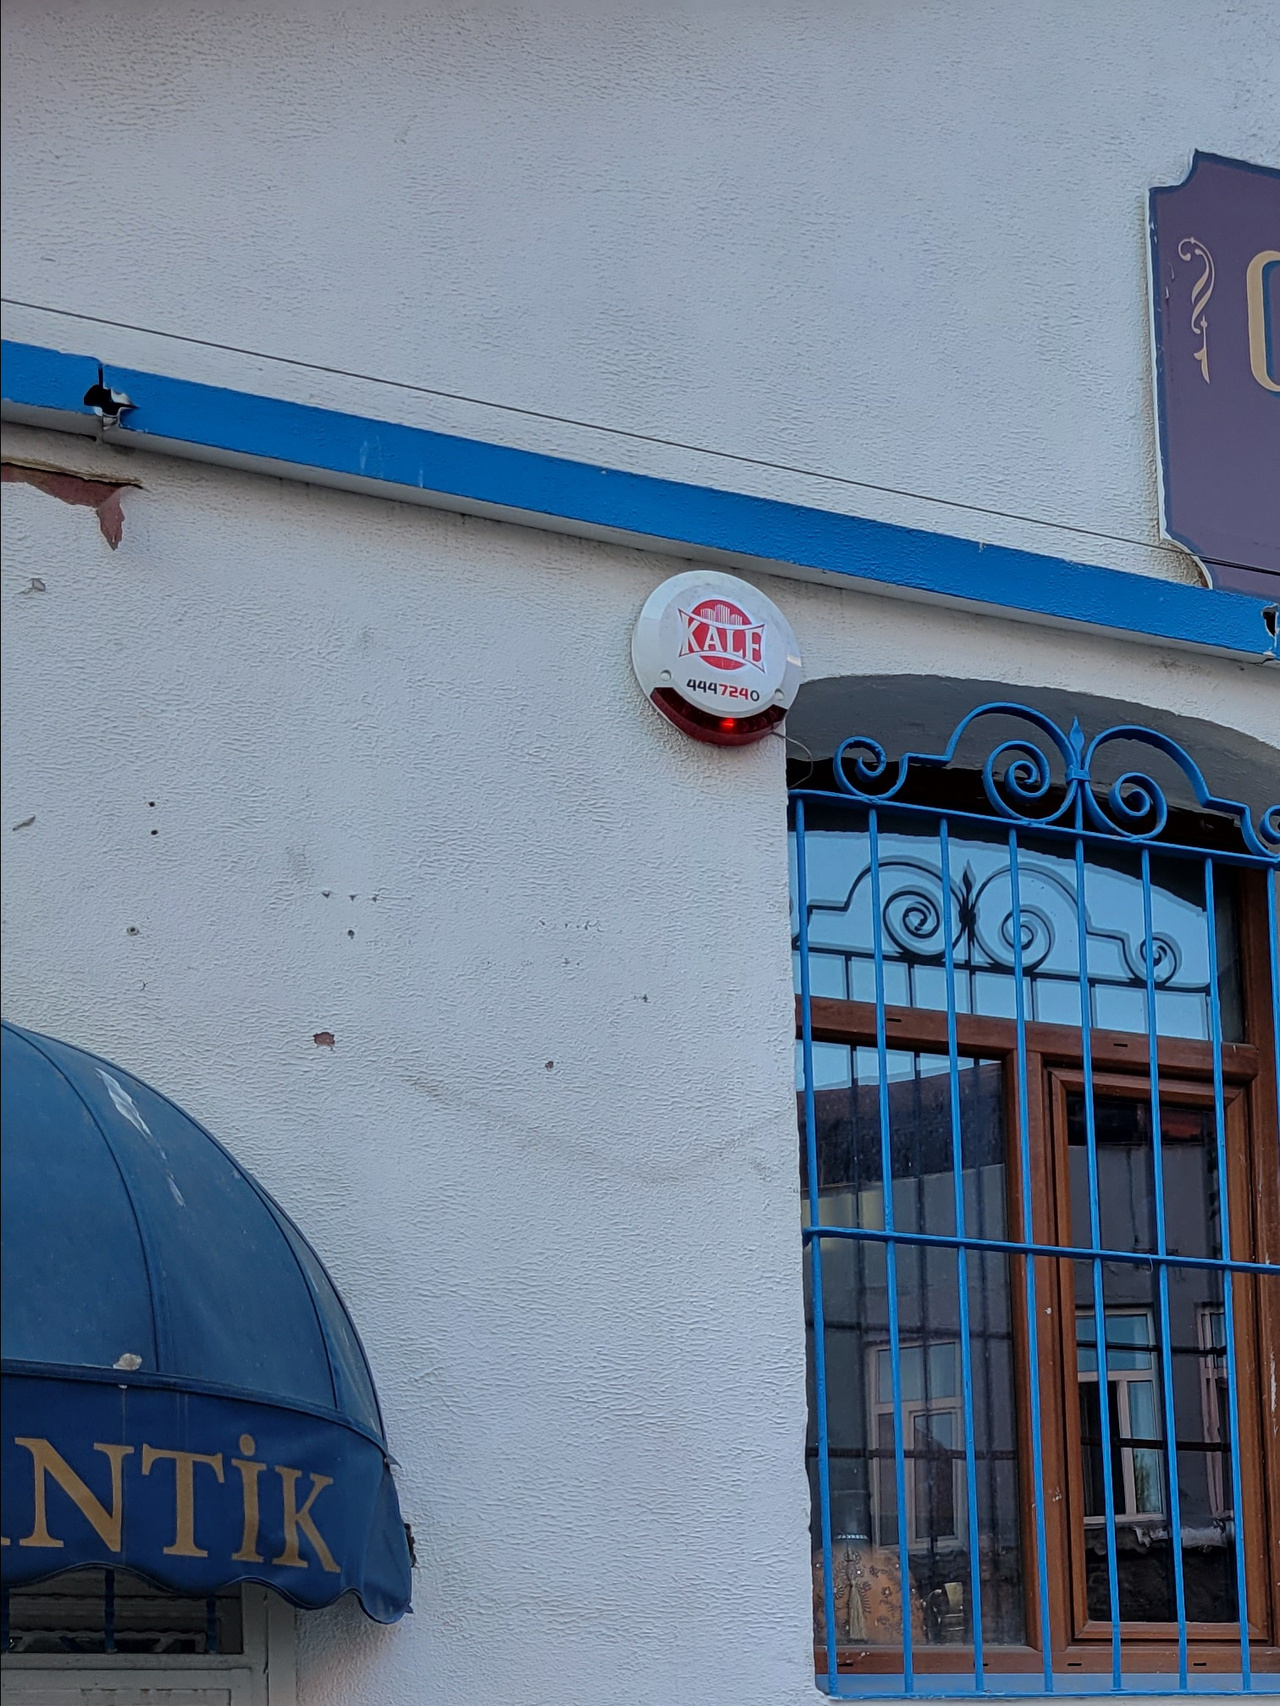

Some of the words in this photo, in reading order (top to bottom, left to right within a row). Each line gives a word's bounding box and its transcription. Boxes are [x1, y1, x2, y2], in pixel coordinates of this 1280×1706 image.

[679, 609, 765, 673] KALE
[686, 678, 760, 702] 4447240
[0, 1434, 341, 1574] NTİK
